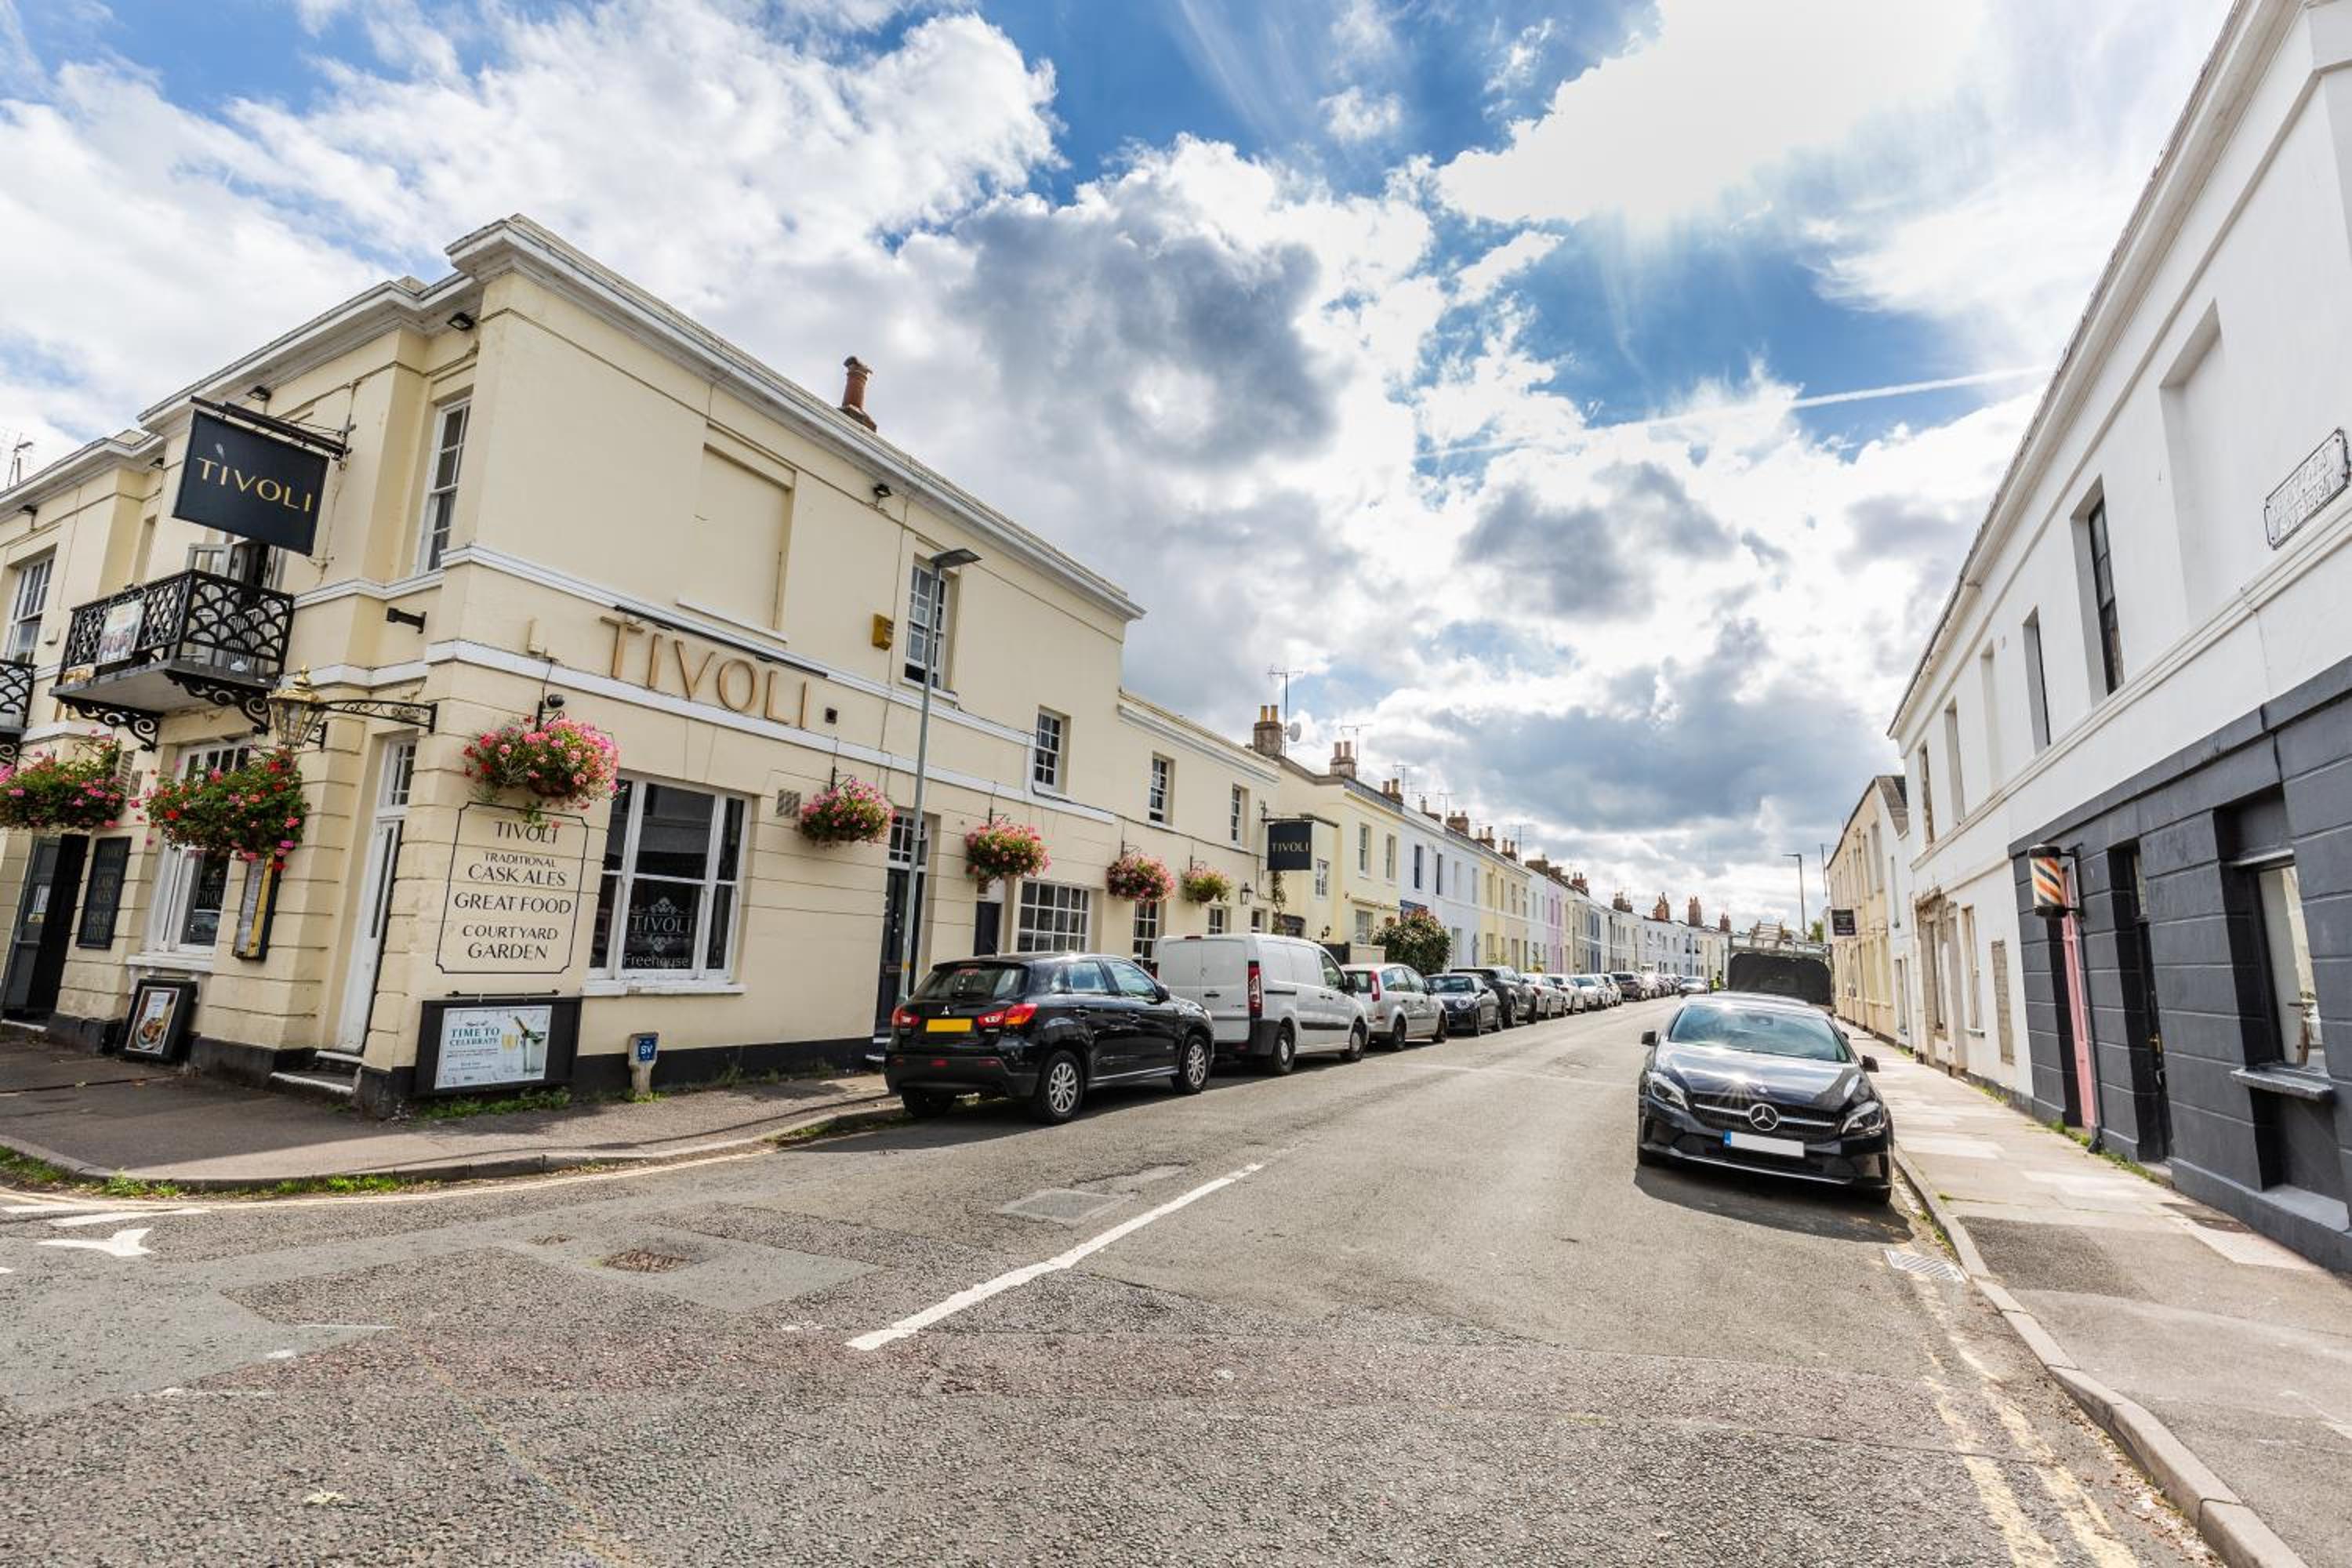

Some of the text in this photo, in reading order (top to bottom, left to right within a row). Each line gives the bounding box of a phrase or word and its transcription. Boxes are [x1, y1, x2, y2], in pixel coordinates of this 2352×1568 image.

[196, 457, 312, 513] TIVOLI
[600, 615, 810, 730] TIVOLI
[493, 821, 557, 844] TIVOLI
[1272, 841, 1309, 853] TIVOLI
[485, 852, 556, 868] TRADITIONAL
[468, 863, 567, 887] CASK ALES
[454, 891, 572, 914] GREAT FOOD
[463, 924, 558, 940] COURTYARD
[631, 915, 692, 934] TIVOLI
[467, 942, 548, 960] GARDEN
[623, 953, 689, 967] Freehouse
[452, 1027, 499, 1038] TIME TO
